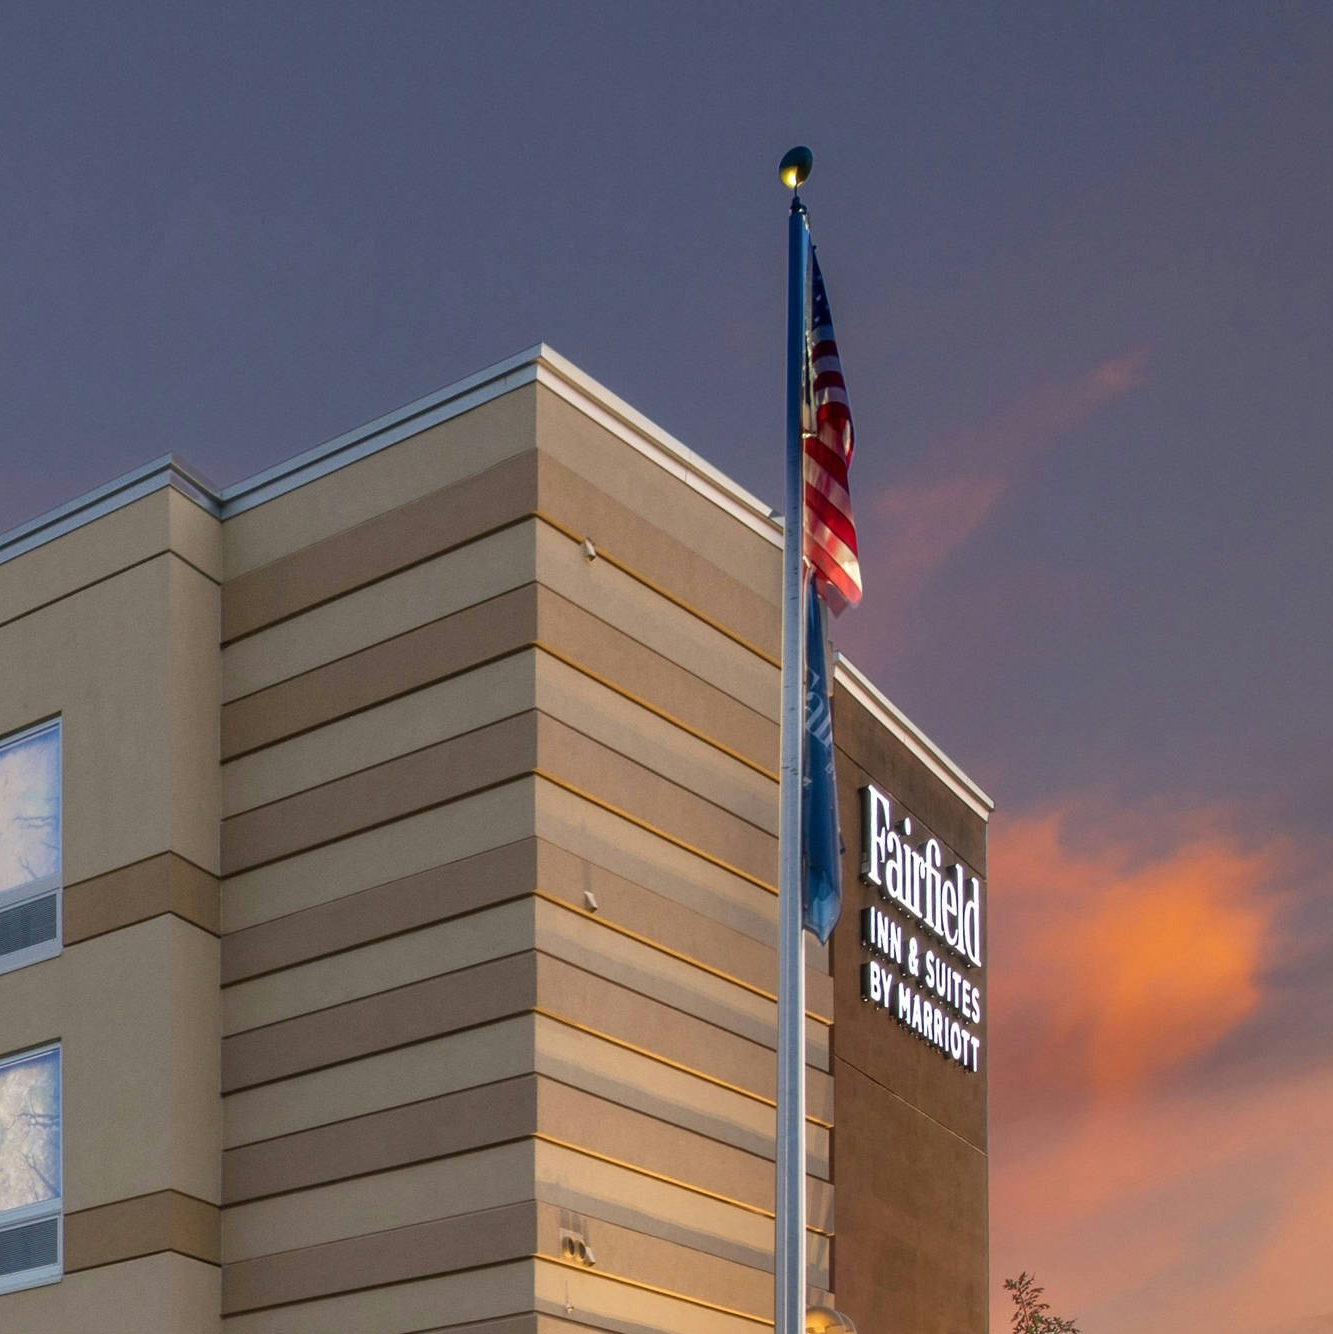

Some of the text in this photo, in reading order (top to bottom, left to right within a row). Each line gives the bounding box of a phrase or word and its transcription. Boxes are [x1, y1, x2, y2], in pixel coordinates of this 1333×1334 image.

[868, 784, 982, 968] Fairfield
[870, 906, 981, 1025] INN & SUITES
[870, 960, 980, 1073] BY MARRIOTT
